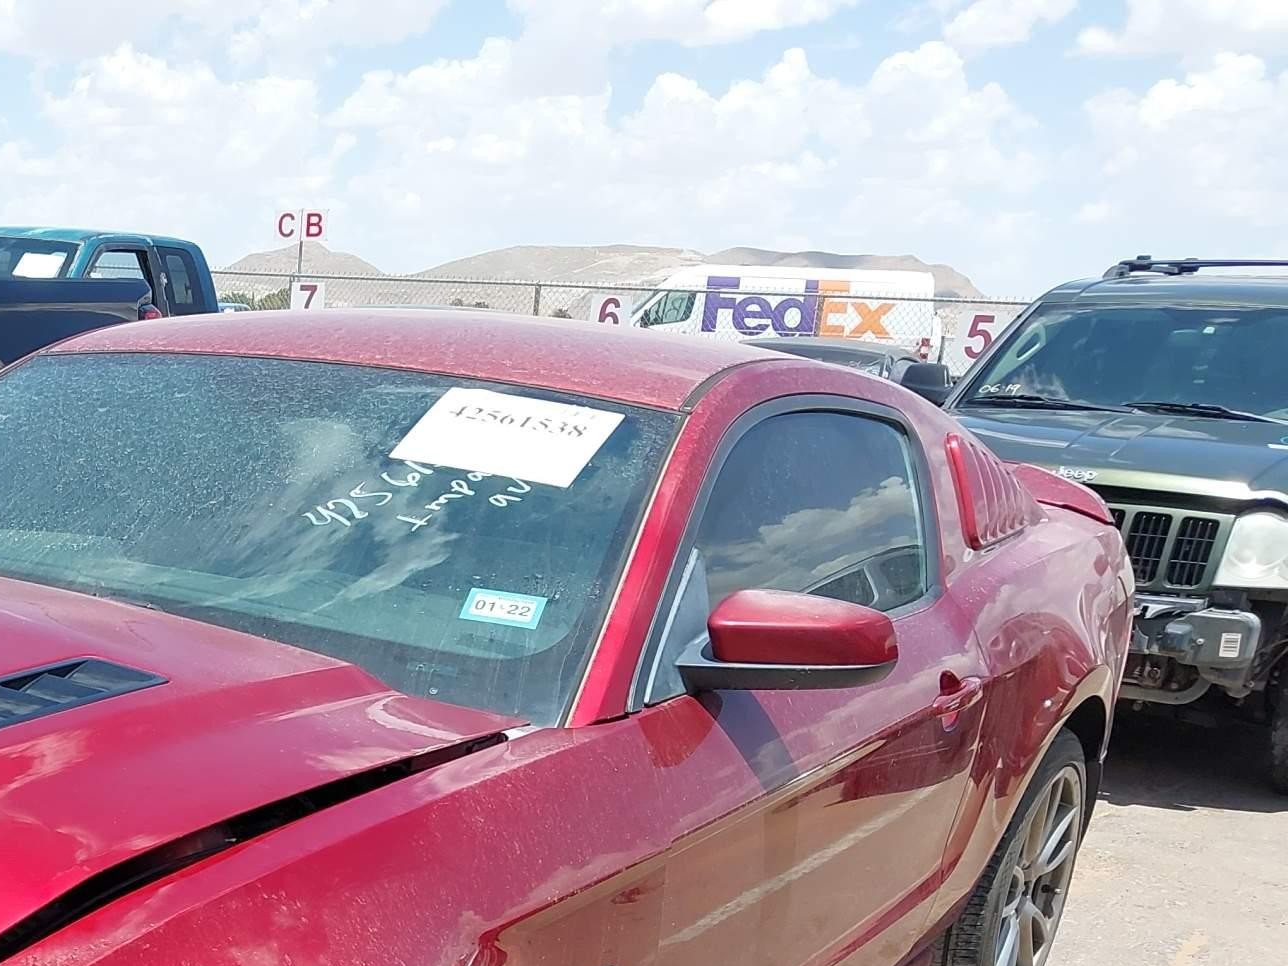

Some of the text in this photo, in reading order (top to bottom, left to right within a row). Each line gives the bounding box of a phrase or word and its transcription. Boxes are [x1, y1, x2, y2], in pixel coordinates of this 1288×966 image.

[278, 213, 295, 238] C
[306, 213, 323, 238] B
[300, 285, 318, 309] 7
[598, 298, 621, 325] 6
[701, 276, 894, 338] FedEx
[964, 315, 995, 360] 5
[449, 405, 588, 438] 42561538
[302, 460, 447, 527] 42561
